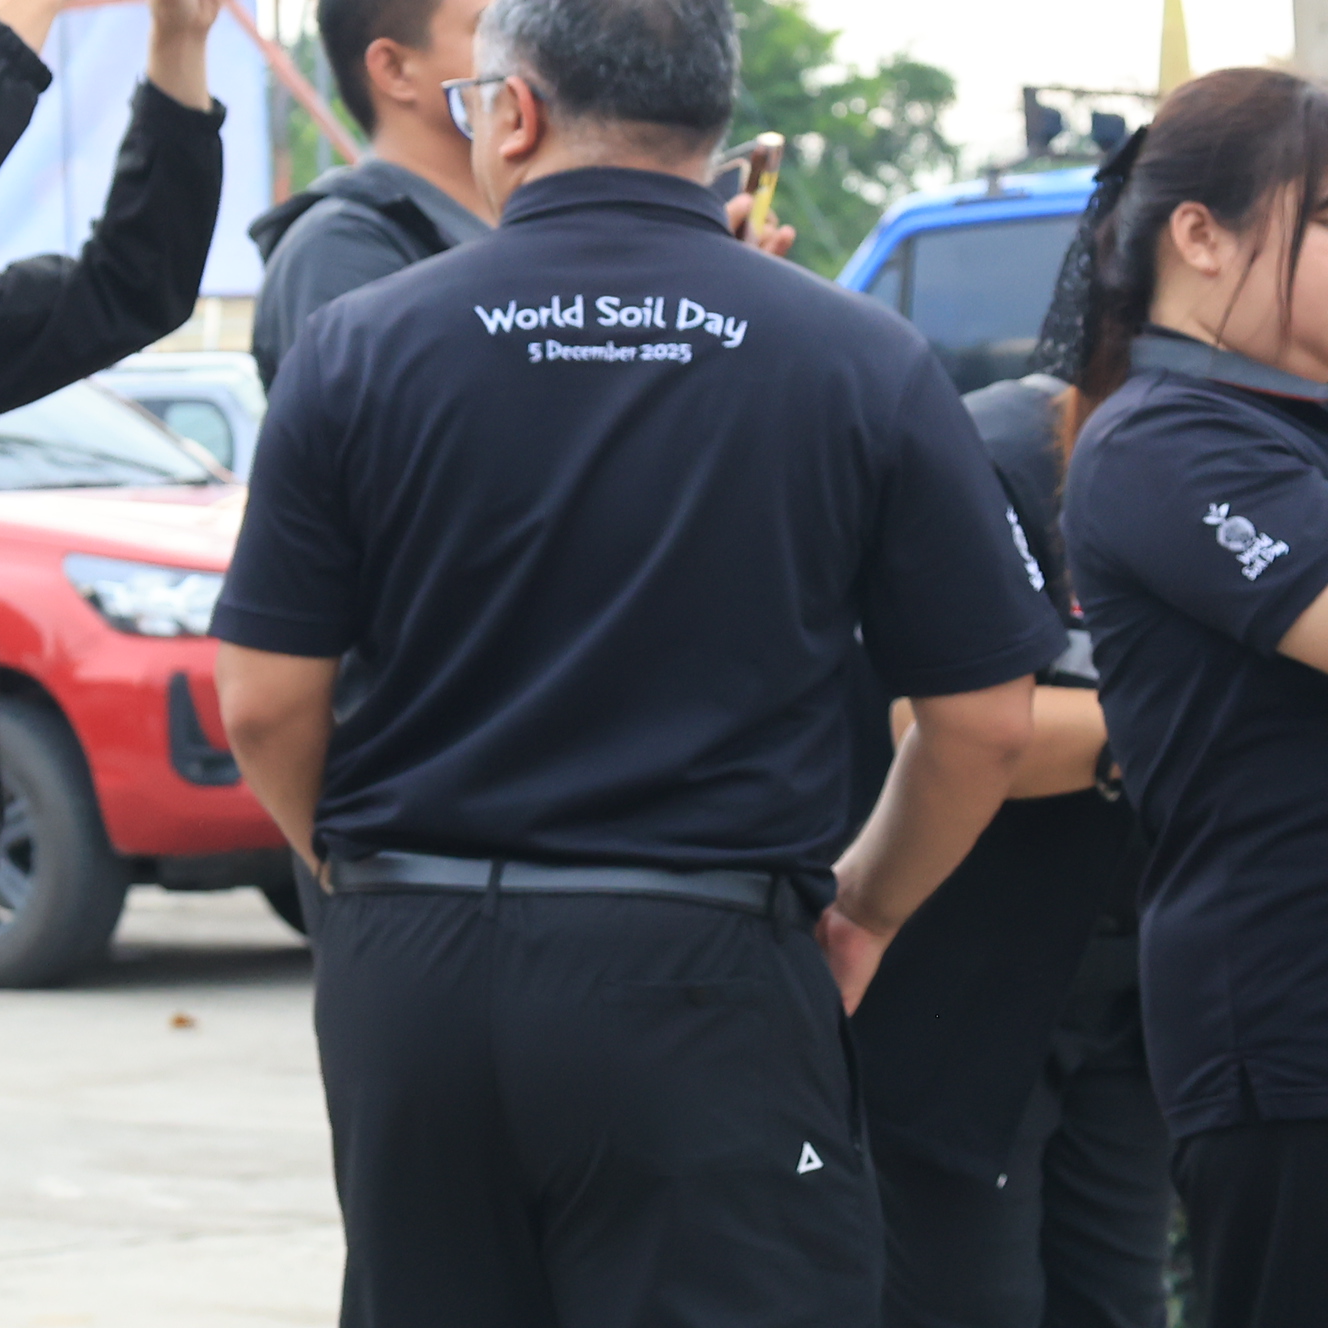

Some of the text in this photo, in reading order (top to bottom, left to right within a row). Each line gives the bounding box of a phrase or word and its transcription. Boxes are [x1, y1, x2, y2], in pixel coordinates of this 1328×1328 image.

[473, 294, 748, 348] World Soil Day
[527, 339, 693, 364] 5 December 2025
